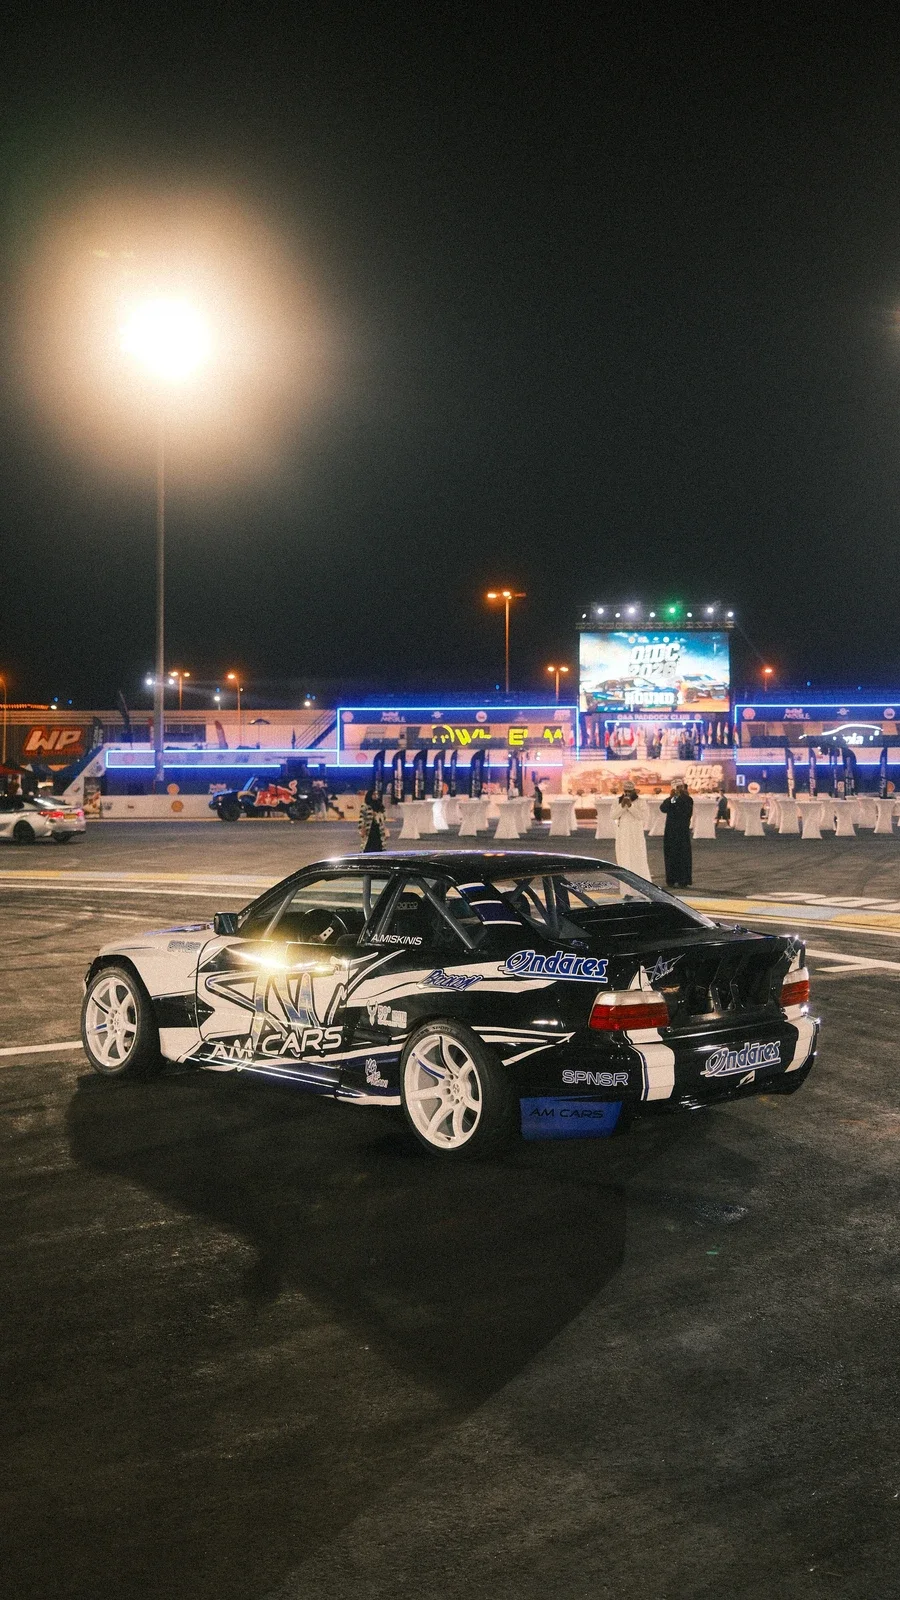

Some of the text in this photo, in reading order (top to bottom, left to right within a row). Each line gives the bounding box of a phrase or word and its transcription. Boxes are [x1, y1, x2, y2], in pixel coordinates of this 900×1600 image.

[635, 713, 669, 721] PADDOCK
[670, 713, 690, 721] CLUB
[25, 730, 82, 750] WP
[371, 934, 423, 946] A.MISKINIS
[504, 949, 609, 982] Ondāres
[206, 1026, 343, 1063] AM CARS
[701, 1041, 781, 1077] Ondāres
[562, 1070, 629, 1087] SPNSR
[529, 1108, 604, 1119] AM CARS
